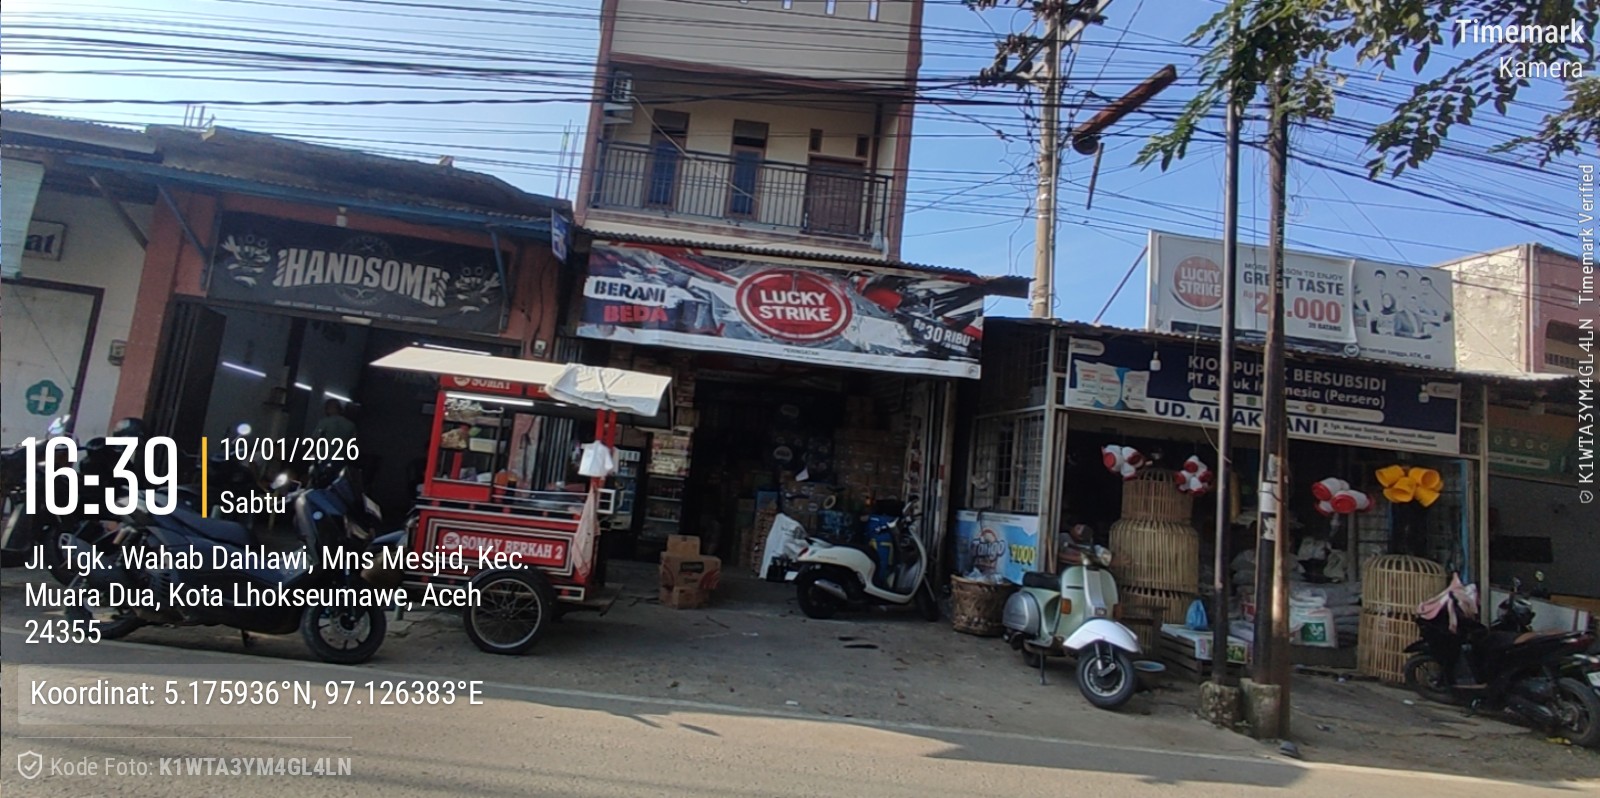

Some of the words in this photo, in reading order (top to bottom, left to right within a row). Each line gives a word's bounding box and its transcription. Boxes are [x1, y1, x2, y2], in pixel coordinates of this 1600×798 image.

[24, 233, 56, 254] at
[281, 247, 441, 307] HANDSOME
[1181, 266, 1220, 284] LUCKY
[1243, 271, 1292, 289] GRET
[1296, 277, 1345, 296] TASTE
[594, 279, 666, 304] BERANI
[760, 289, 828, 308] LUCKY
[1178, 281, 1222, 298] STRIKE
[604, 304, 669, 323] BEDA
[758, 304, 832, 323] STRIKE
[1255, 291, 1341, 324] 2.000
[923, 324, 943, 343] 30
[1188, 355, 1221, 372] KIO
[1293, 368, 1387, 392] BERSUBSIDI
[1187, 371, 1203, 385] PT
[1207, 374, 1250, 391] Puk
[1254, 379, 1321, 398] Inesia
[1324, 389, 1385, 410] (Persero)
[1154, 400, 1191, 419] UD.
[1198, 406, 1262, 428] AAK
[460, 535, 504, 551] SOMAY
[504, 540, 553, 558] BERKAH
[554, 545, 564, 559] 2
